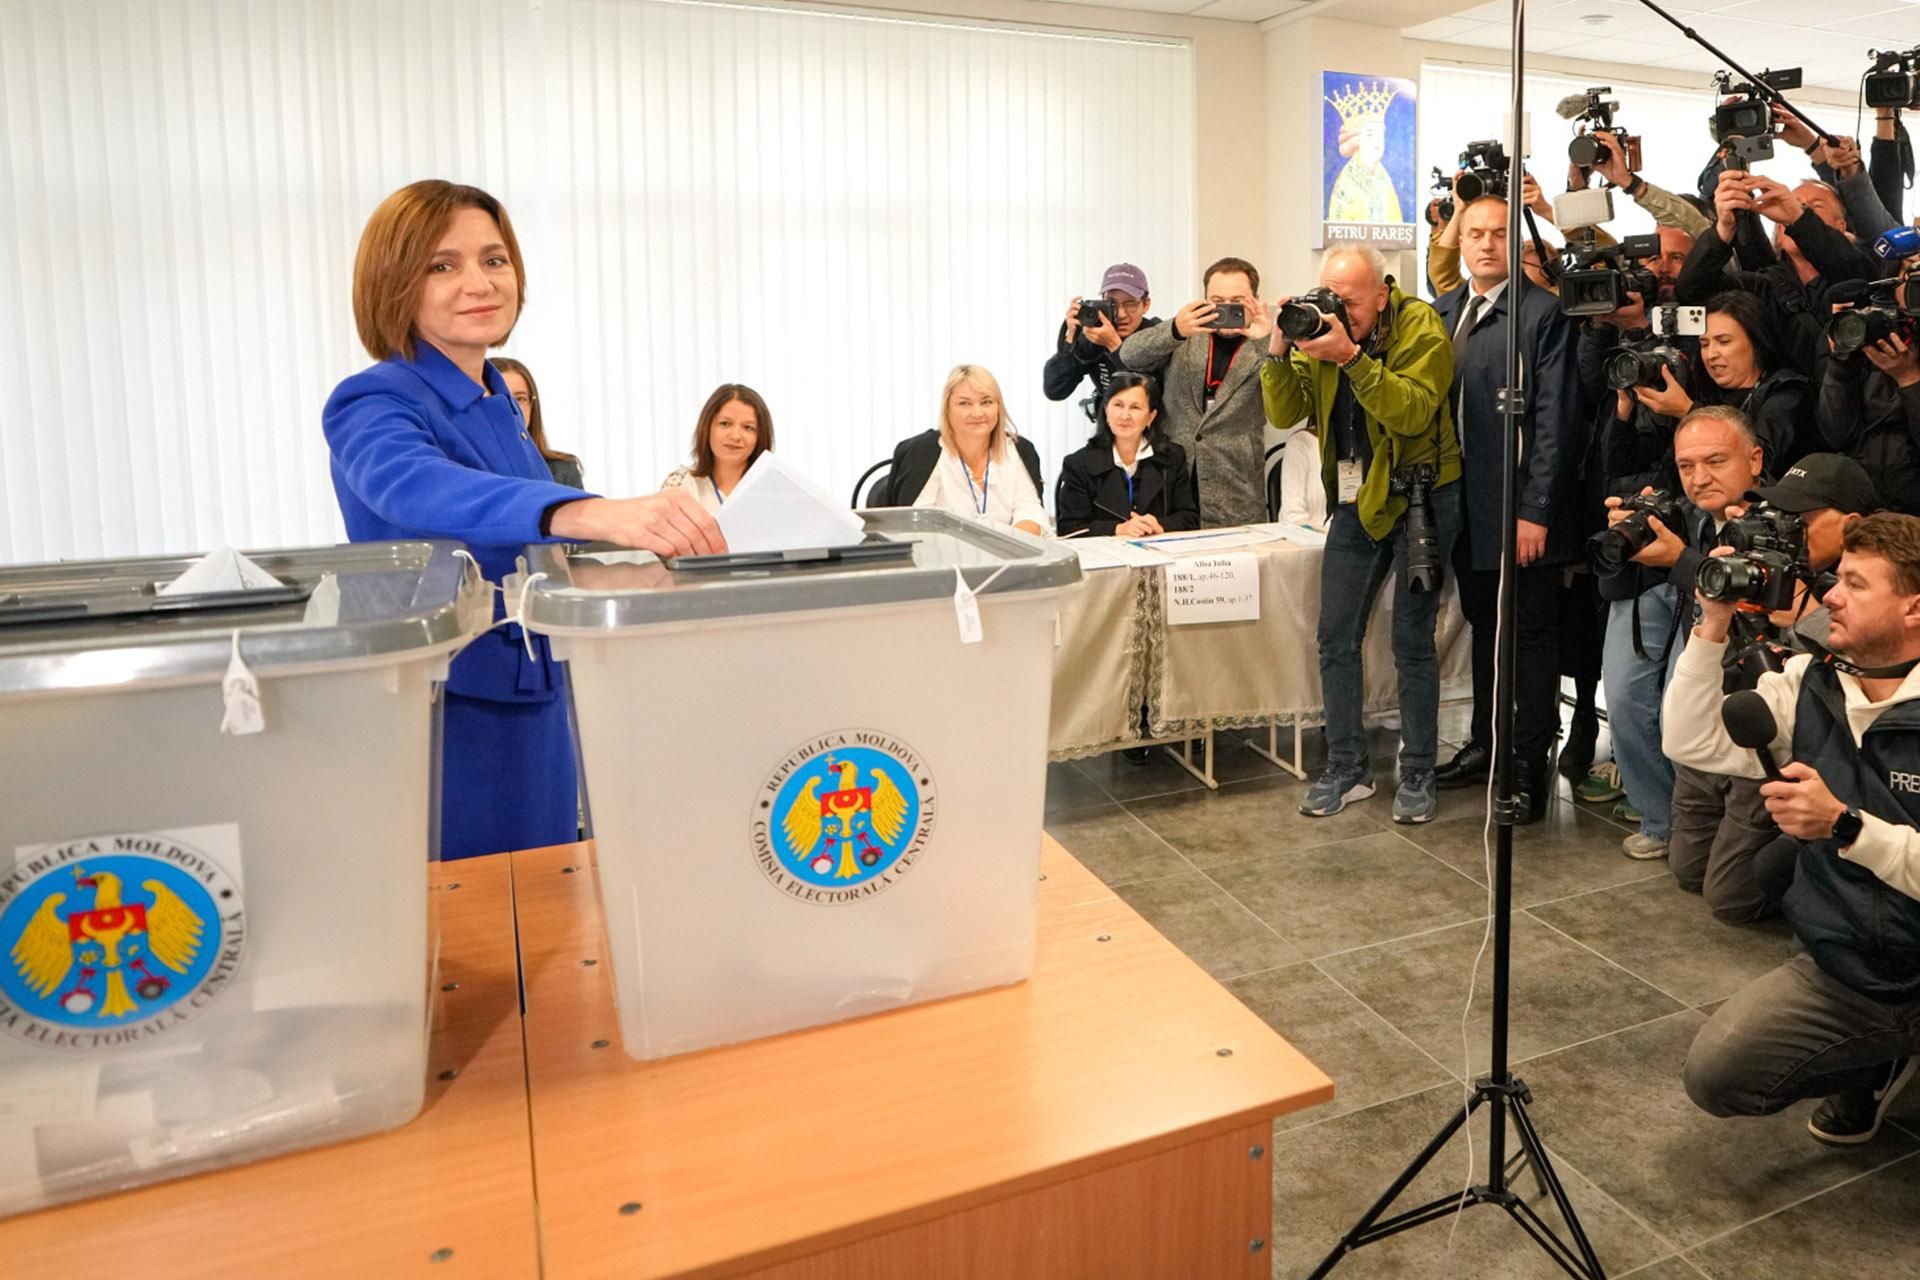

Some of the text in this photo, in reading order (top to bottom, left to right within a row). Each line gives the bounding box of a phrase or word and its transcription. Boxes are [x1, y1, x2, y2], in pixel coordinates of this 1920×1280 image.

[1328, 225, 1367, 239] PETRU
[1174, 585, 1194, 593] 188/2
[766, 733, 919, 792] REPUBLICA MOLDOVA
[1890, 771, 1920, 793] PRE
[113, 838, 216, 882] MOLDOVA
[752, 821, 784, 884] COMISIA
